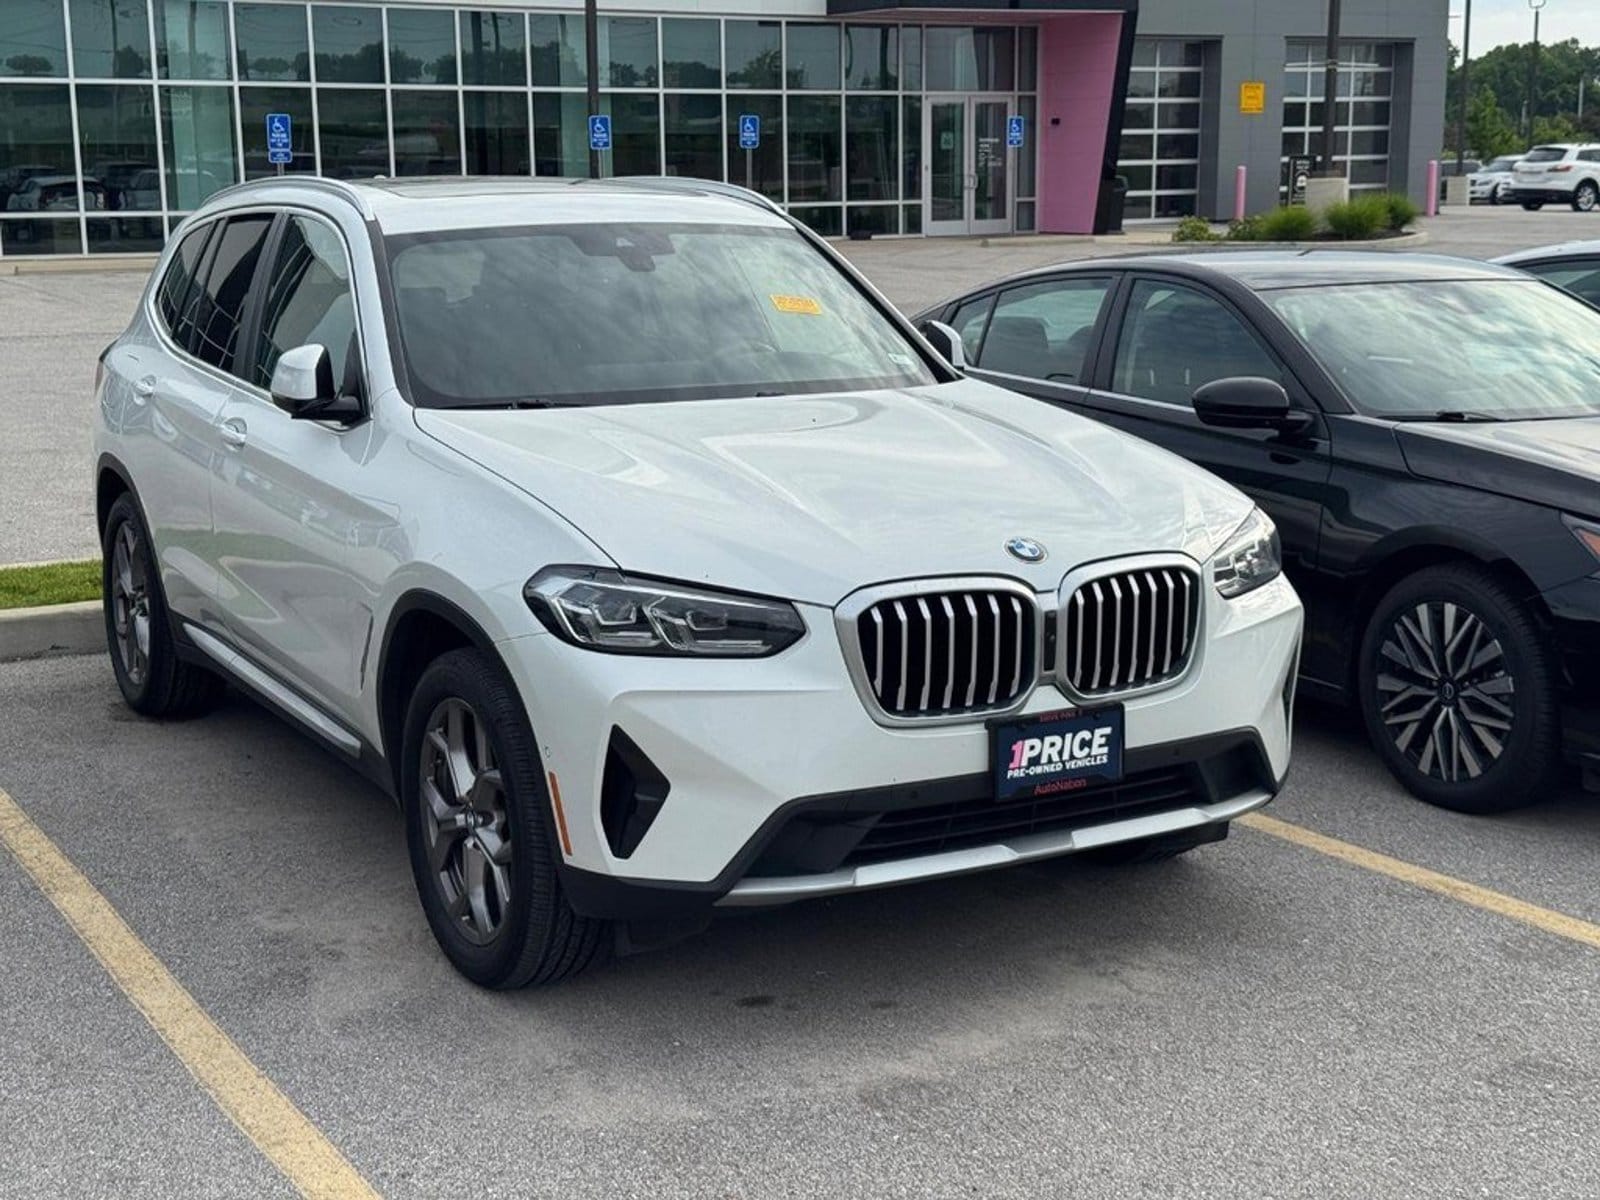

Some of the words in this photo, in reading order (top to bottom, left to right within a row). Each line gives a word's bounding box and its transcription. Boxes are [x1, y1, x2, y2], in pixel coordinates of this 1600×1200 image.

[1009, 727, 1113, 769] 1PRICE
[1007, 763, 1063, 779] PRE-OWNED
[1064, 754, 1108, 770] VEHICLES
